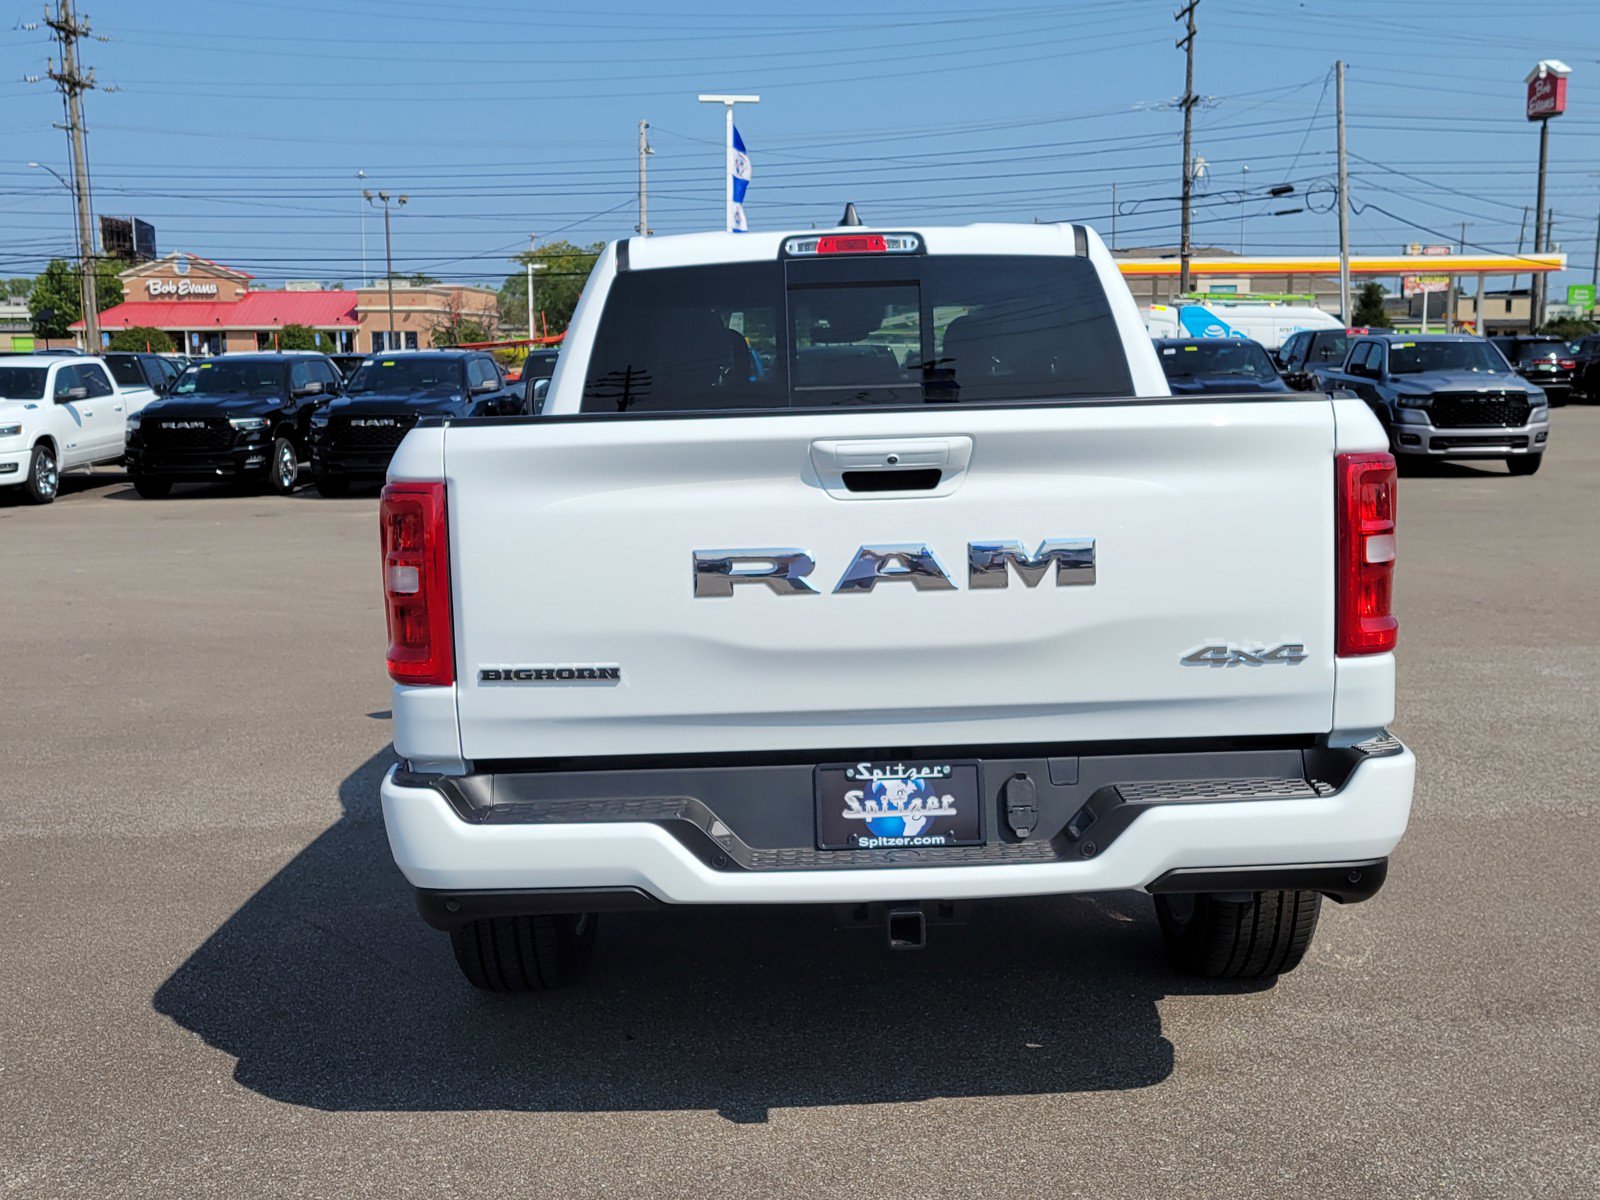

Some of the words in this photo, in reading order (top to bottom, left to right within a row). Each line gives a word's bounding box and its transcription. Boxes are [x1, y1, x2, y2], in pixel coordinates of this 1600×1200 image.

[1535, 80, 1551, 98] Bob
[145, 278, 177, 295] Bob
[177, 278, 218, 296] Evans
[161, 421, 205, 429] RAM
[350, 419, 395, 427] RAM
[692, 537, 1097, 598] RAM
[478, 663, 620, 687] BIGHORN
[855, 762, 944, 781] Spitzer
[842, 789, 957, 822] Spitzer
[858, 835, 946, 849] Spitzer.com
